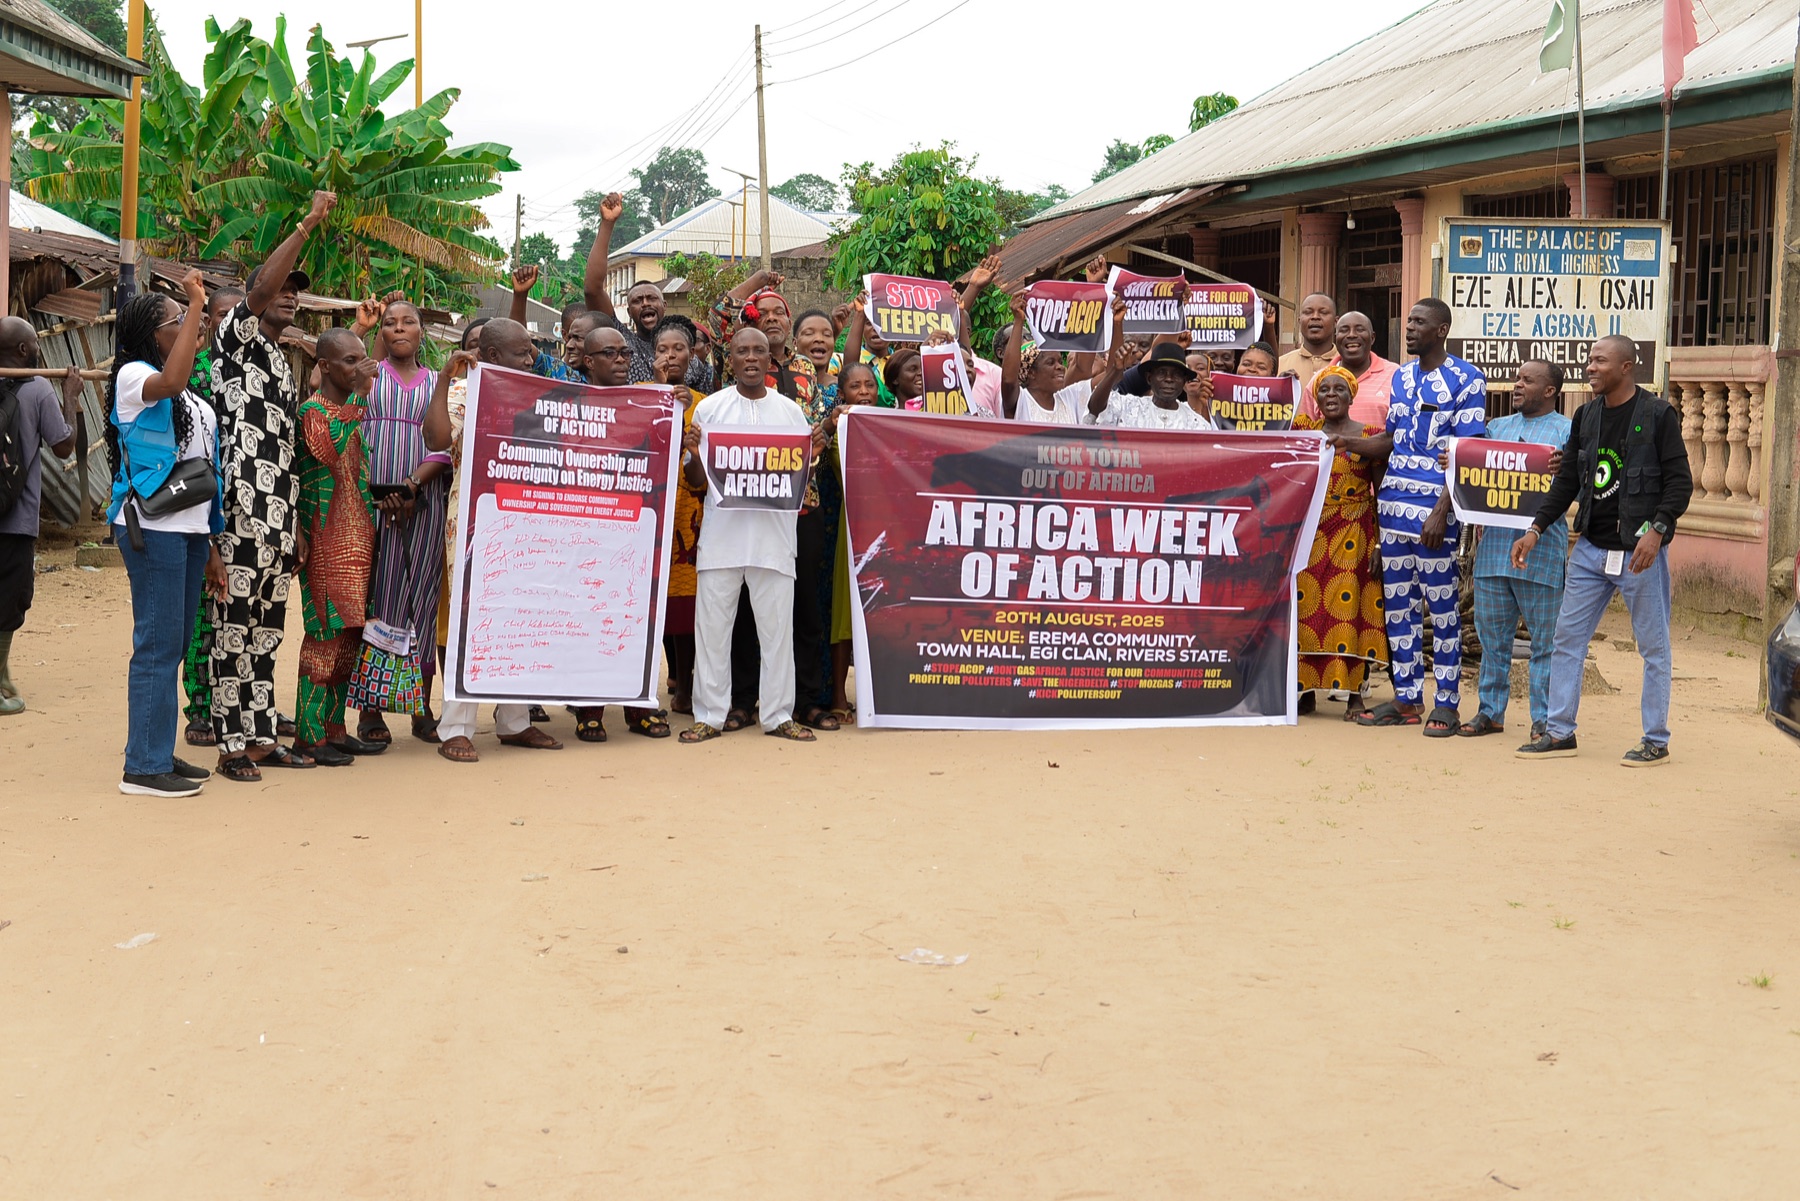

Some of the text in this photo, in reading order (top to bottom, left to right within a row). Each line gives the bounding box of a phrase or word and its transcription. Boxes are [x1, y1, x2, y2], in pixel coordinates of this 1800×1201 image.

[1488, 229, 1621, 251] THE PALACE OF
[1487, 252, 1620, 274] HIS ROYAL HIGHNESS
[886, 282, 941, 311] STOP
[1209, 291, 1227, 303] FOR
[1229, 291, 1249, 303] OUR
[1452, 276, 1492, 308] EZE
[1505, 277, 1563, 309] ALEX.
[1600, 279, 1654, 310] OSAH
[1026, 298, 1103, 334] STOPEACOP
[1122, 299, 1180, 321] GERDELTA
[1185, 304, 1243, 316] OMMUNITIES
[877, 308, 956, 336] TEEPSA
[1195, 317, 1228, 329] PROFIT
[1228, 317, 1247, 329] FOR
[1482, 313, 1520, 337] EZE
[1532, 314, 1597, 338] AGBNA
[1192, 330, 1236, 342] OLLUTERS
[1462, 340, 1525, 364] EREMA,
[1233, 384, 1270, 404] KICK
[535, 399, 616, 424] AFRICA WEEK
[1211, 399, 1294, 421] POLLUTERS
[544, 417, 607, 439] OF ACTION
[498, 441, 648, 474] Community Ownership and
[715, 445, 803, 472] DONTGAS
[1037, 445, 1142, 469] KICK TOTAL
[1485, 450, 1528, 472] KICK
[487, 460, 653, 493] Sovereignty on Energy Justice
[723, 473, 793, 498] AFRICA
[1021, 469, 1155, 493] OUT OF AFRICA
[1459, 466, 1552, 493] POLLUTERS
[502, 499, 634, 518] OWNERSHIP AND SOVEREIGNTY ON ENERGY JUSTICE
[522, 489, 619, 506] I'M SIGNING TO ENDORSE COMMUNITY
[1486, 488, 1522, 510] OUT
[924, 500, 1240, 556] AFRICA WEEK
[960, 552, 1203, 603] OF ACTION
[995, 611, 1165, 628] 20TH AUGUST, 2025
[960, 629, 1196, 648] VENUE: EREMA COMMUNITY
[916, 642, 1232, 663] TOWN HALL, EGI CLAN, RIVERS STATE.
[909, 674, 1232, 689] PROFIT FOR POLLUTERS #SAVETHENIGERDELTA #STOPMOZGAS #STOPTEEPSA
[923, 663, 1222, 678] #STOPEACOP #DONTGASAFRICA JUSTICE FOR OUR COMMUNITIES NOT
[1028, 689, 1122, 699] #KICKPOLLUTERSOUT
